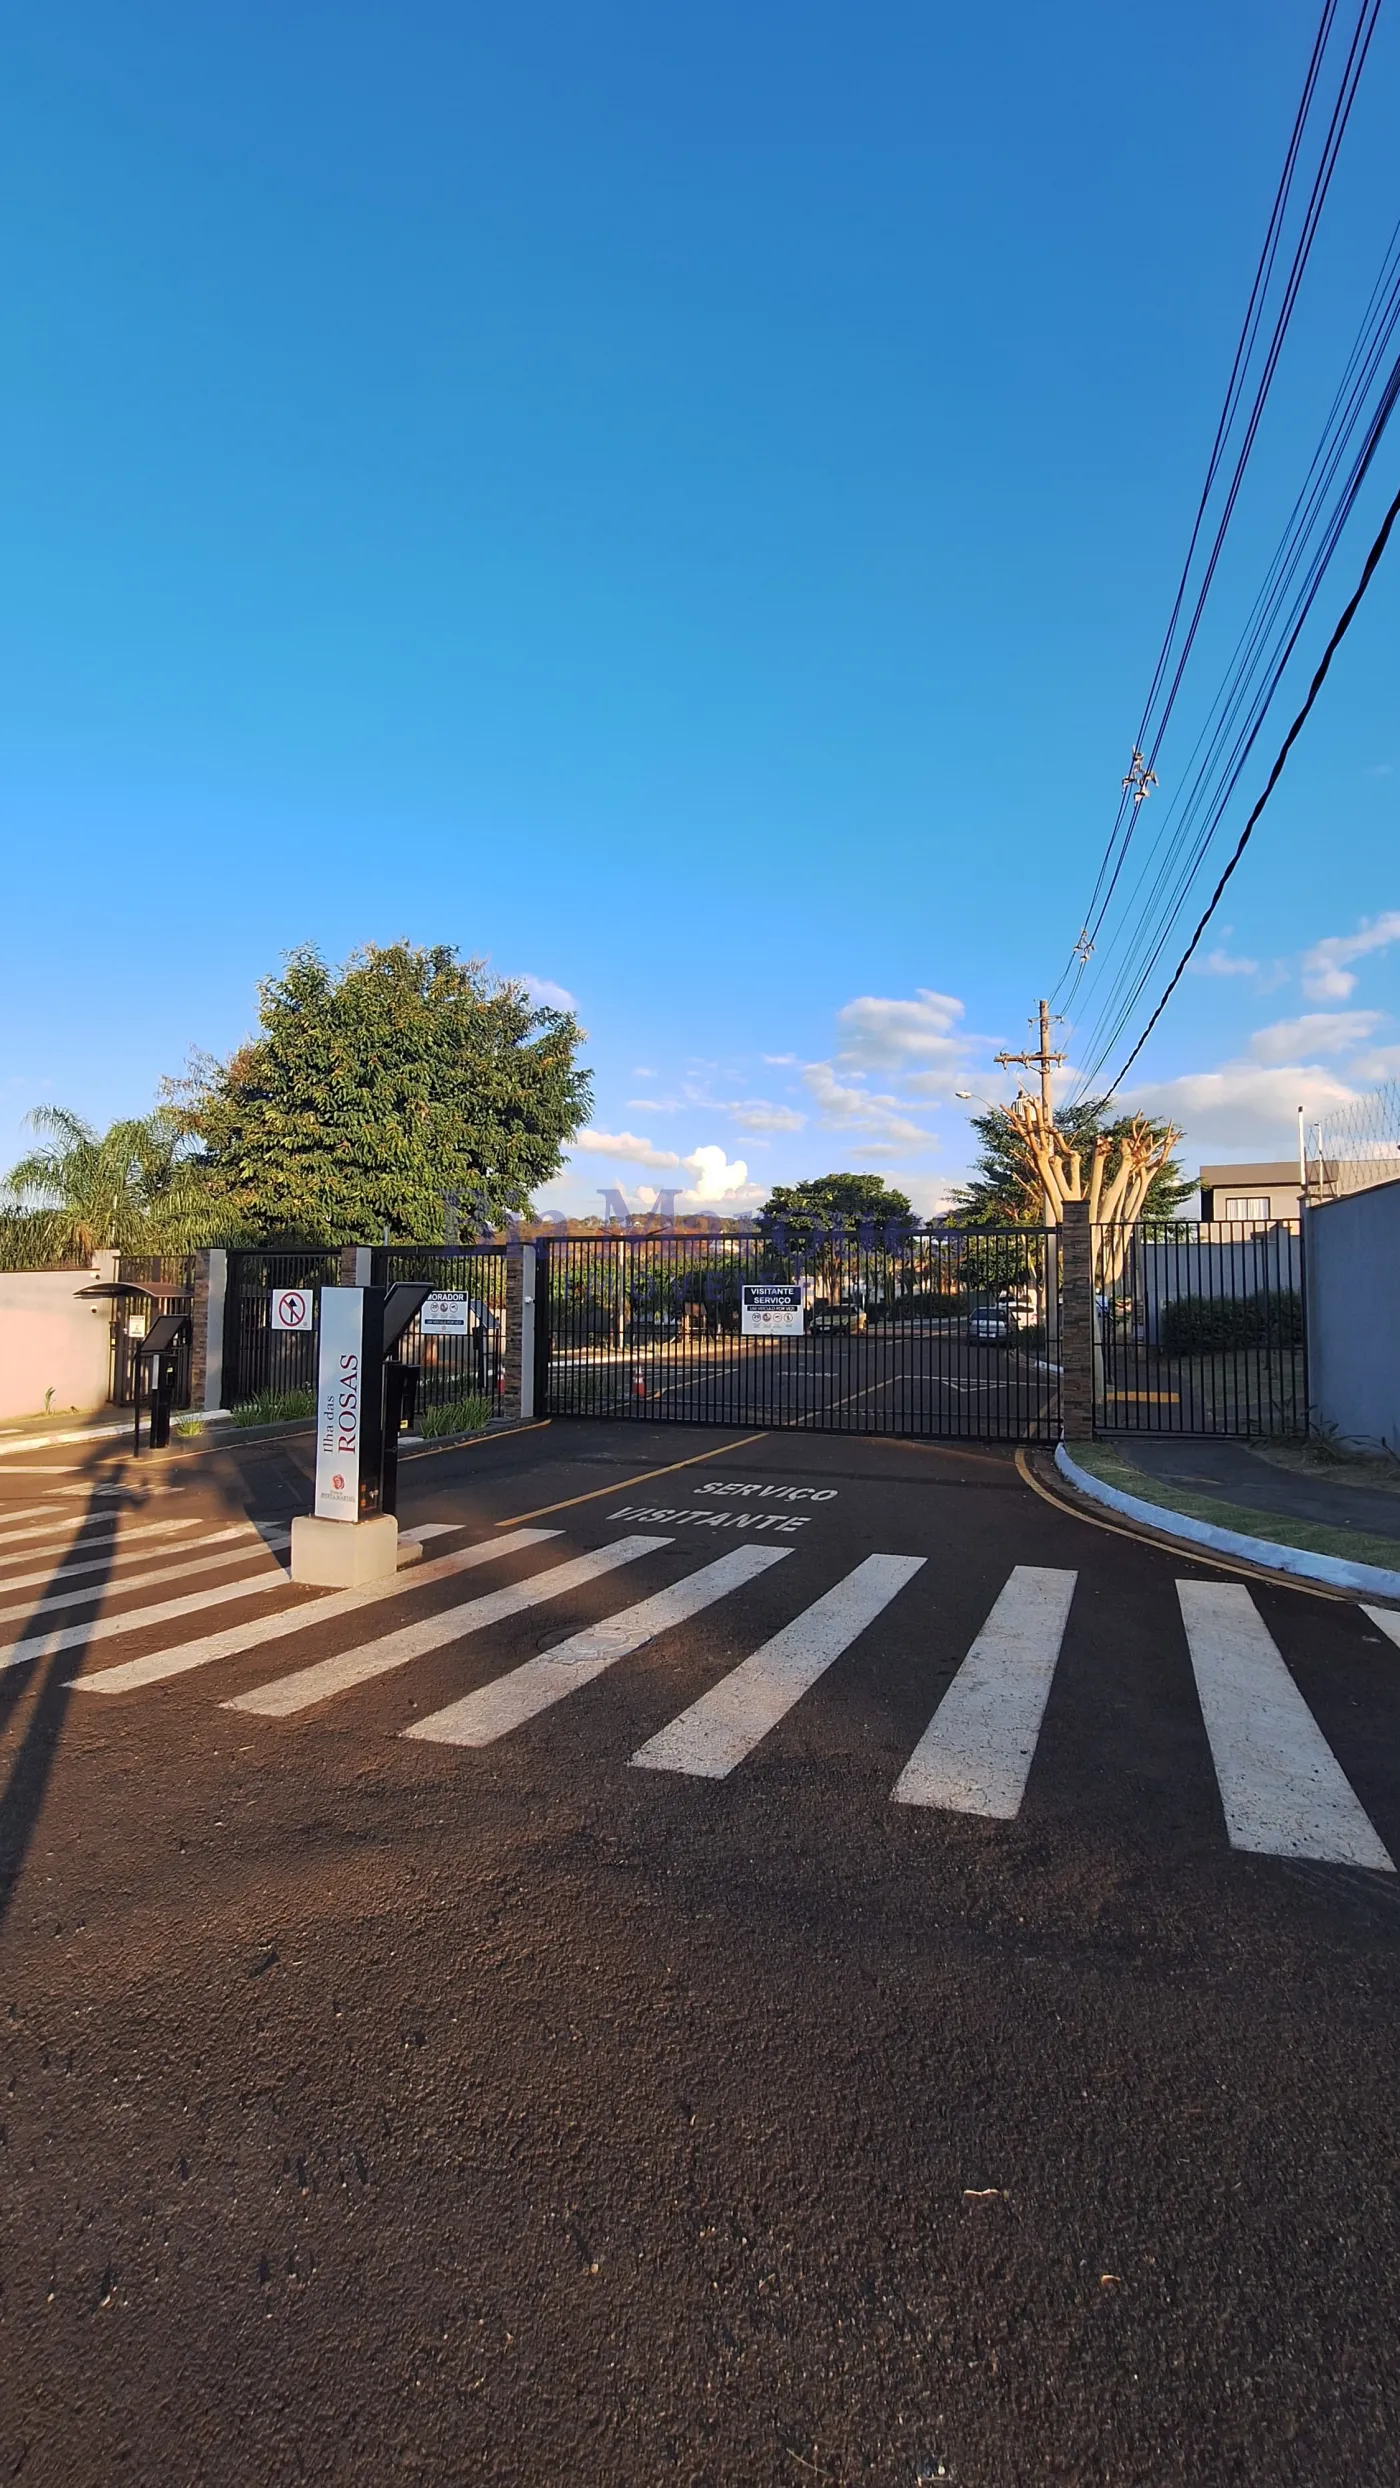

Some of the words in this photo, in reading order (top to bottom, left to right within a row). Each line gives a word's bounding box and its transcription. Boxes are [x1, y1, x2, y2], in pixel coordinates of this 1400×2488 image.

[754, 1297, 791, 1305] SERVIÇO
[323, 1395, 335, 1421] das
[338, 1354, 358, 1455] ROSAS
[322, 1425, 335, 1453] Ilha
[693, 1481, 839, 1502] SERVIÇO
[605, 1506, 812, 1532] VISITANTE
